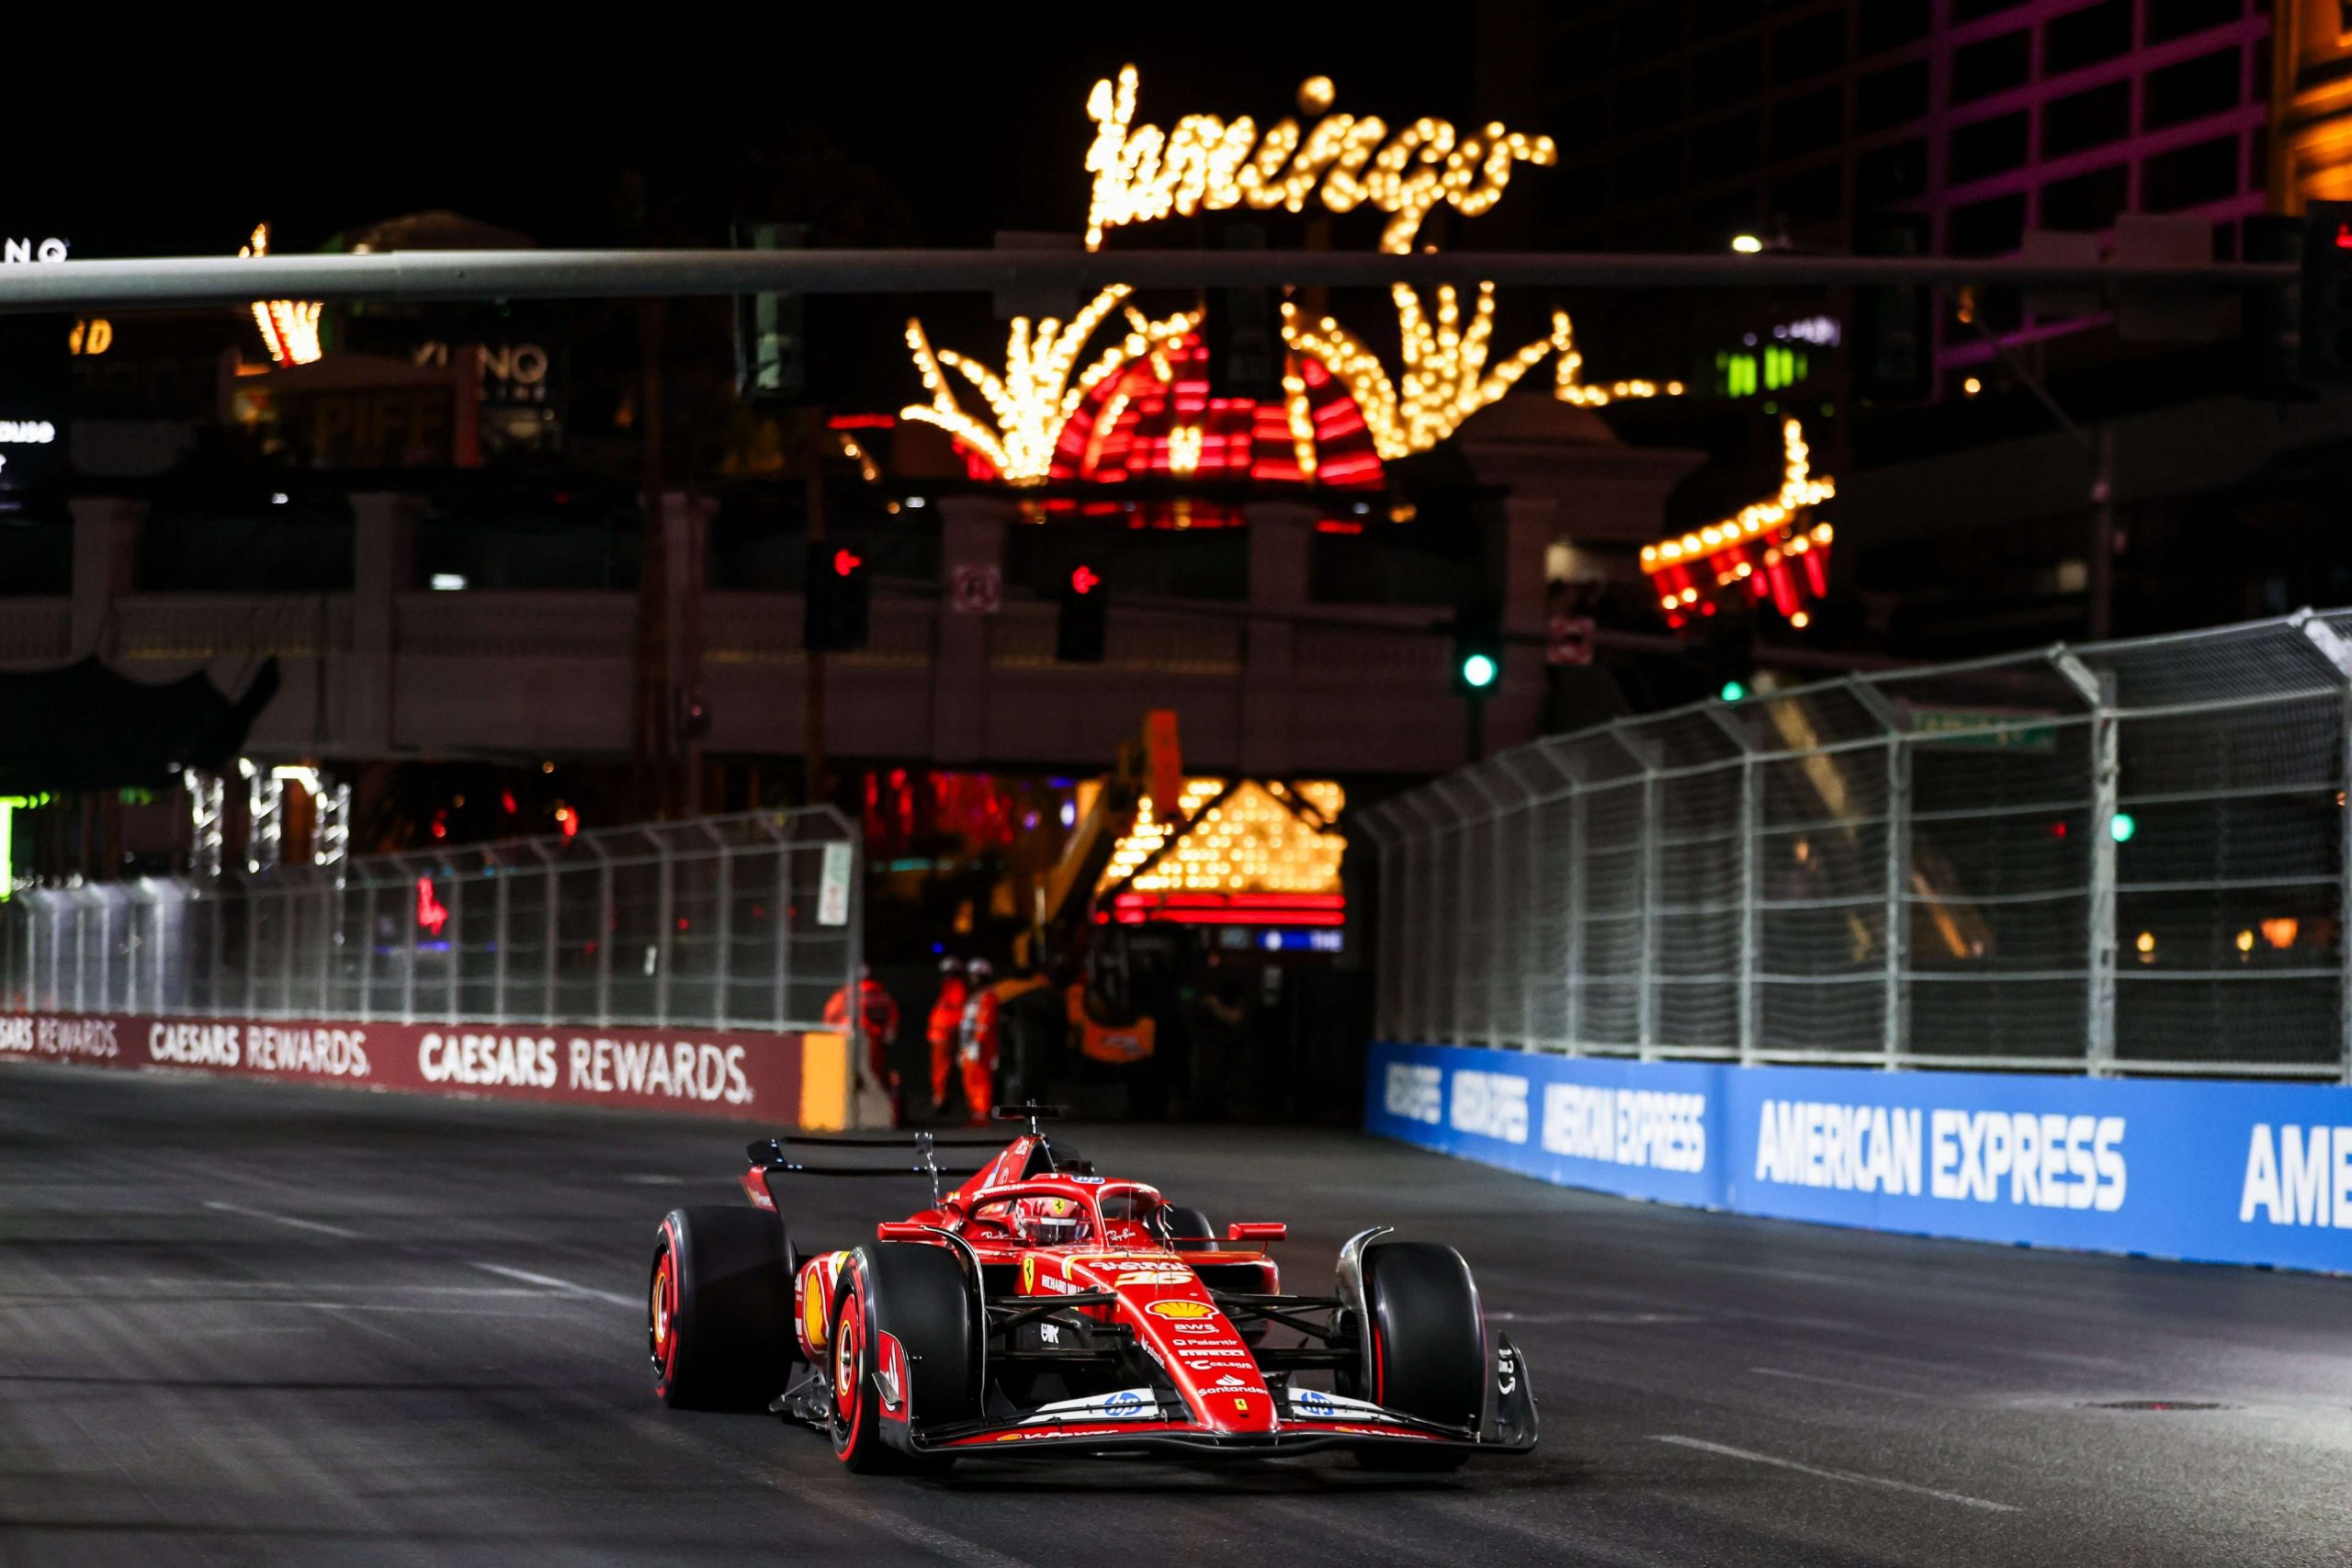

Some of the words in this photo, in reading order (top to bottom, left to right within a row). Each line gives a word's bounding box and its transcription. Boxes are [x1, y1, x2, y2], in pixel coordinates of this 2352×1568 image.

[149, 1022, 241, 1066] CAESARS
[245, 1024, 369, 1077] REWARDS
[419, 1033, 558, 1089] CAESARS
[569, 1038, 750, 1104] REWARDS
[1755, 1100, 1921, 1197] AMERICAN
[1931, 1108, 2128, 1212] EXPRESS
[2239, 1122, 2352, 1230] AME
[1114, 1271, 1194, 1288] 16
[1174, 1324, 1217, 1332] aws
[1106, 1393, 1140, 1416] hp
[1198, 1386, 1270, 1396] Santander
